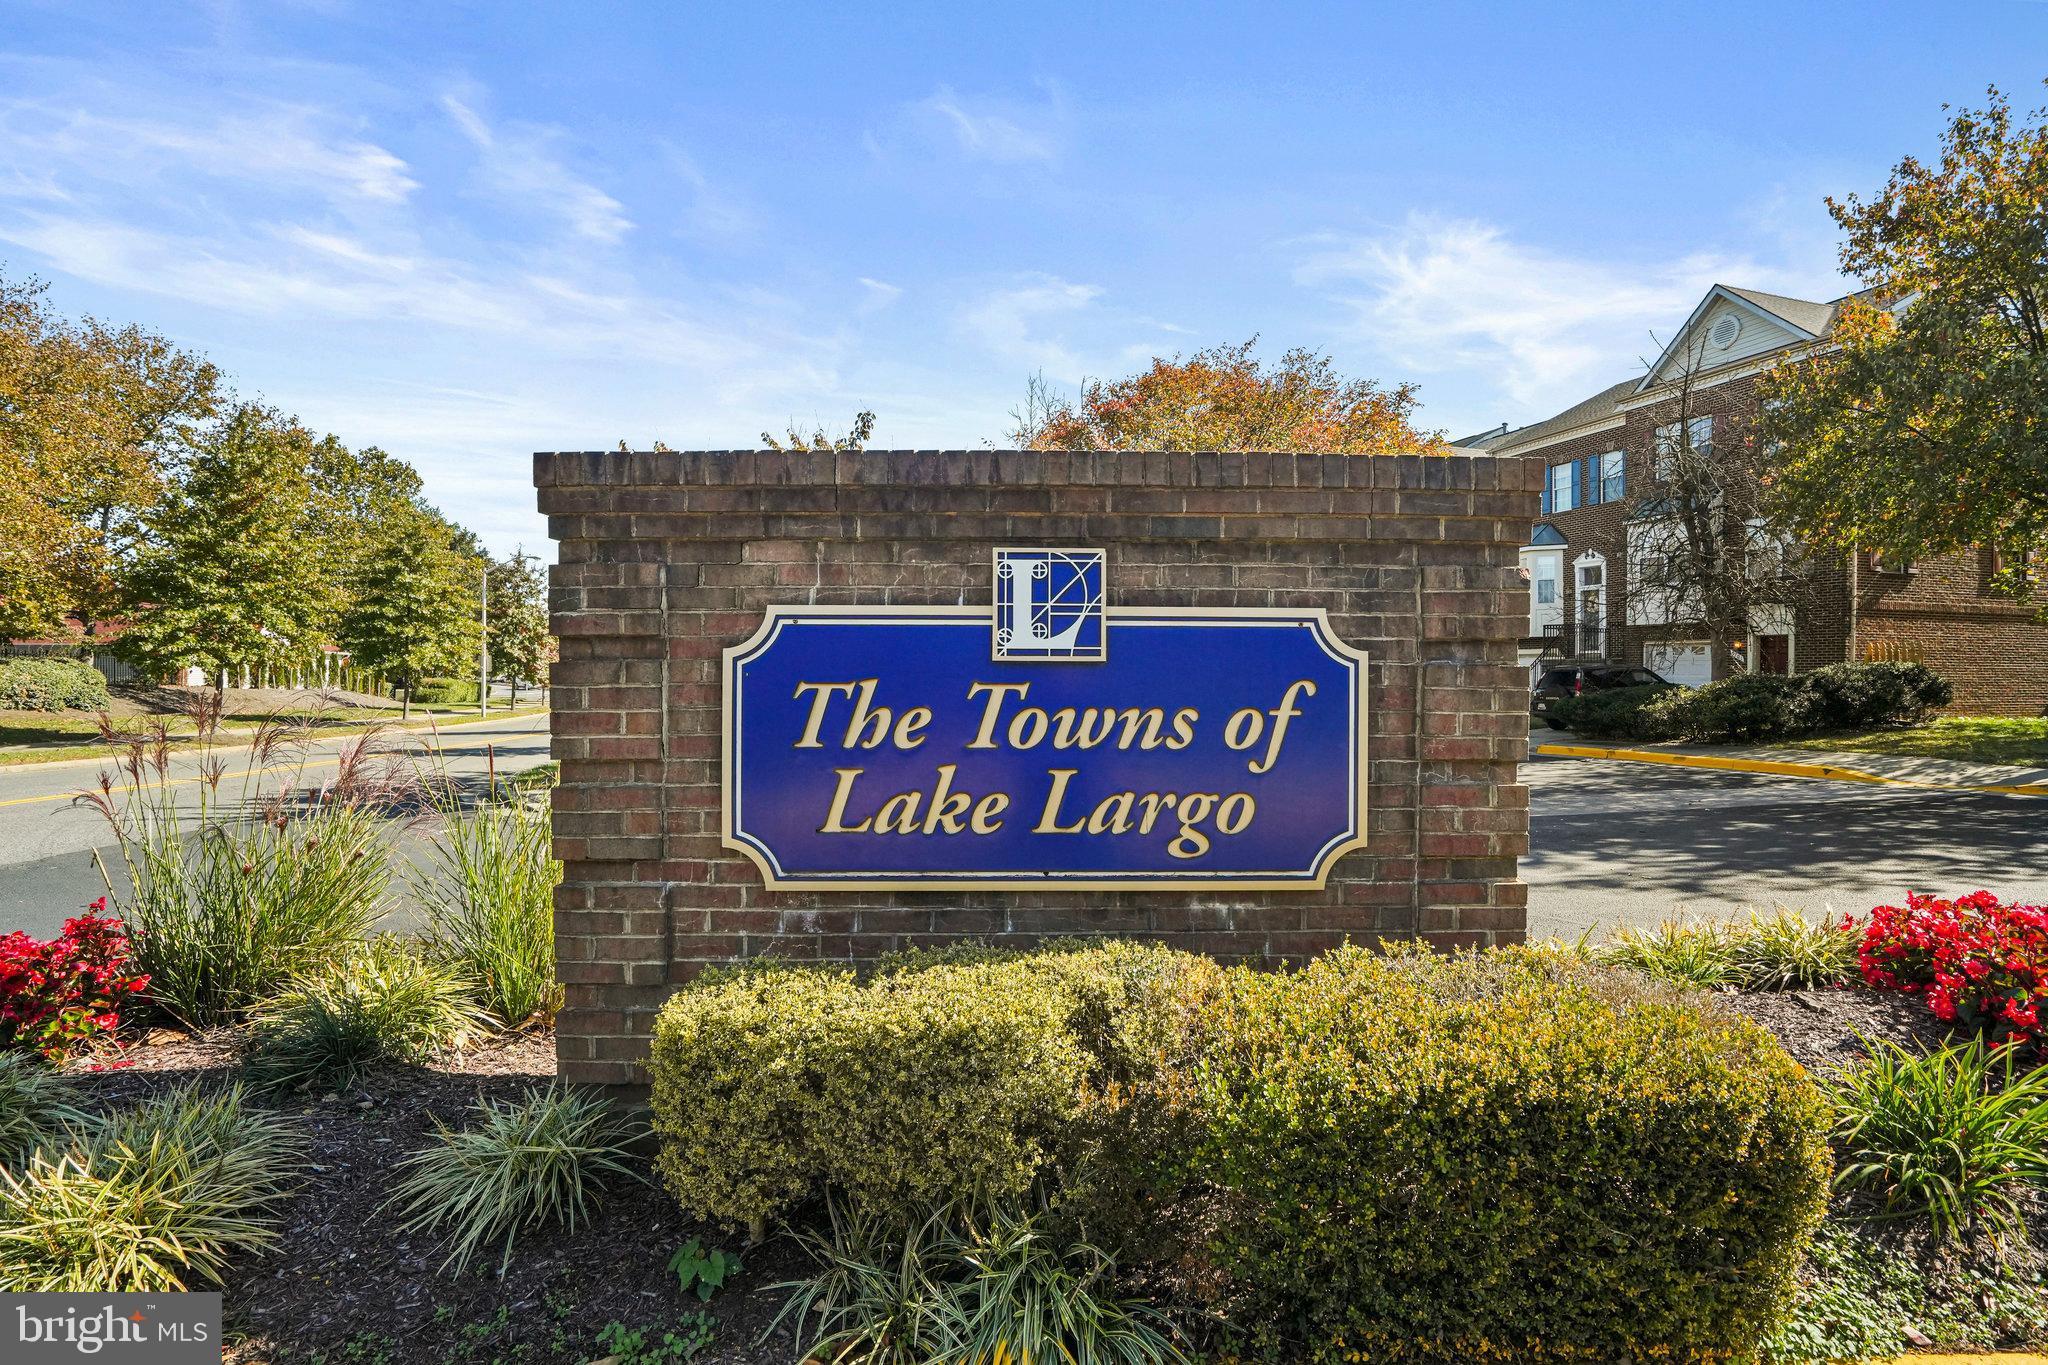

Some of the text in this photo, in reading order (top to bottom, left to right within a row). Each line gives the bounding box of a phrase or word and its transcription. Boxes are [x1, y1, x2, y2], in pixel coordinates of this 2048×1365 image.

[1002, 559, 1086, 650] L
[793, 679, 1317, 774] The Towns of
[818, 764, 1256, 859] Lake Largo
